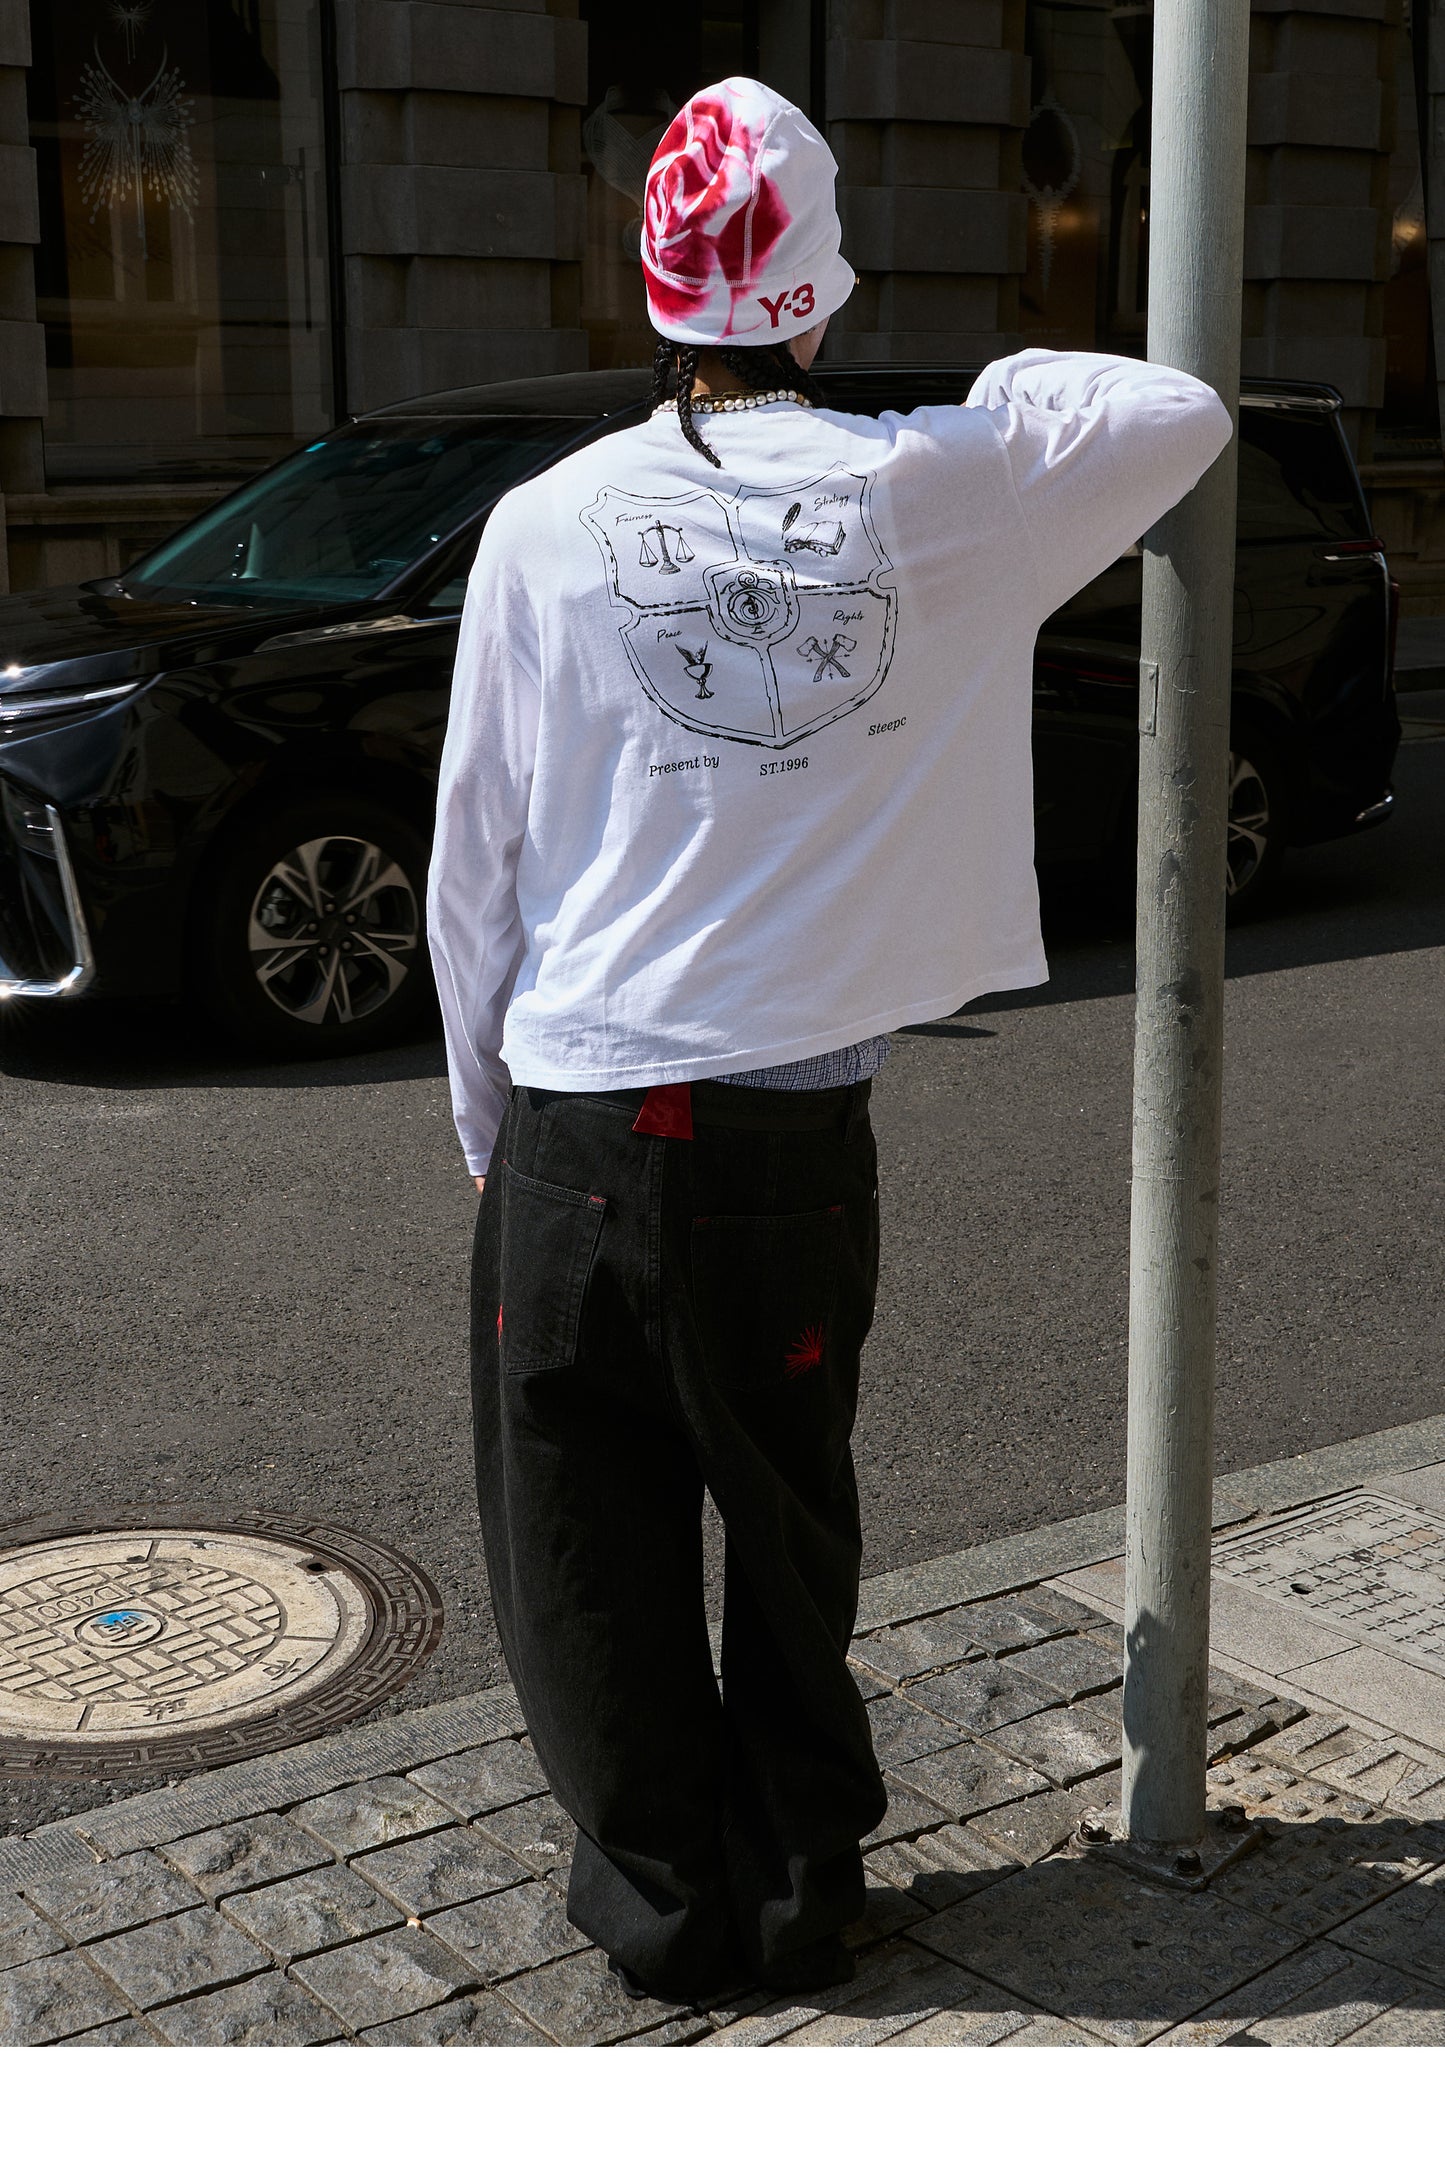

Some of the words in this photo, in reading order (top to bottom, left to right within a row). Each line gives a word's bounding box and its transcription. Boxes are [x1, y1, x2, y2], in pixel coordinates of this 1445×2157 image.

[757, 283, 815, 328] Y-3
[832, 610, 864, 625] Rights
[657, 629, 682, 643] Peace
[868, 716, 907, 736] Steepc
[649, 757, 700, 777] Present
[703, 755, 720, 768] by
[759, 756, 809, 776] ST.1996
[37, 1585, 126, 1619] D400
